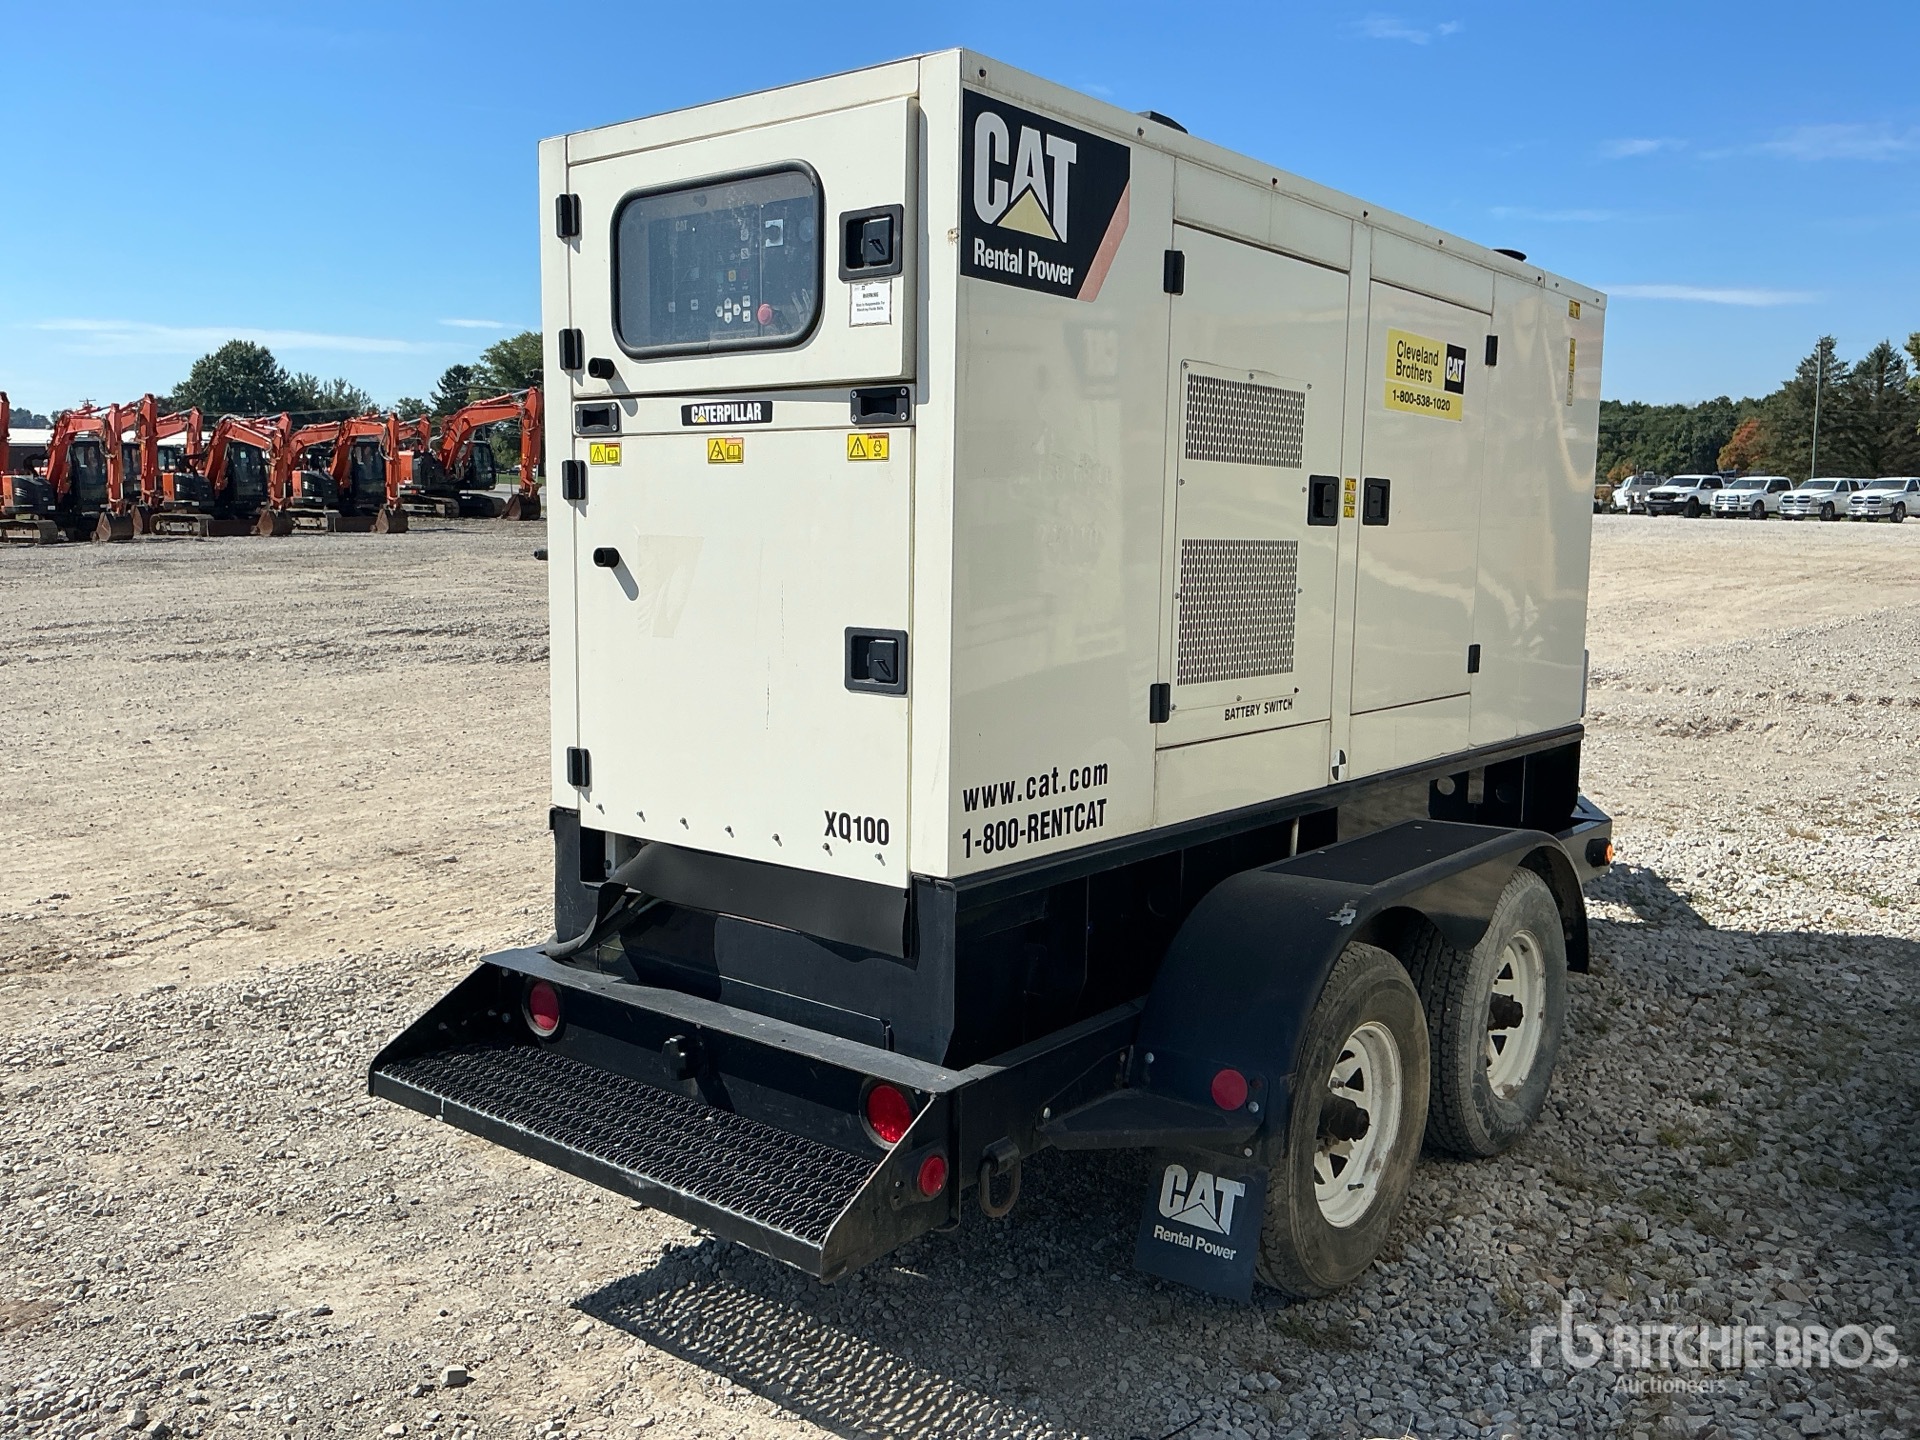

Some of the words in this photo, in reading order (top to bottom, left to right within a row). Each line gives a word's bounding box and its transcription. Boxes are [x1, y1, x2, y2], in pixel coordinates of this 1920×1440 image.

[974, 111, 1077, 243] CAT
[973, 237, 1022, 275] Rental
[1027, 250, 1074, 286] Power
[1395, 358, 1433, 383] Brothers
[1396, 340, 1439, 367] Cleveland
[1446, 356, 1465, 383] CAT
[691, 402, 762, 423] CATERPILLAR
[1392, 389, 1451, 411] 1-800-538-1020
[1224, 703, 1261, 721] BATTERY
[1264, 698, 1293, 714] SWITCH
[962, 763, 1109, 812] www.cat.com
[824, 810, 890, 846] XQ100
[962, 798, 1108, 859] 1-800-RENTCAT
[1158, 1164, 1246, 1236] CAT
[1153, 1224, 1194, 1249] Rental
[1195, 1236, 1237, 1261] Power
